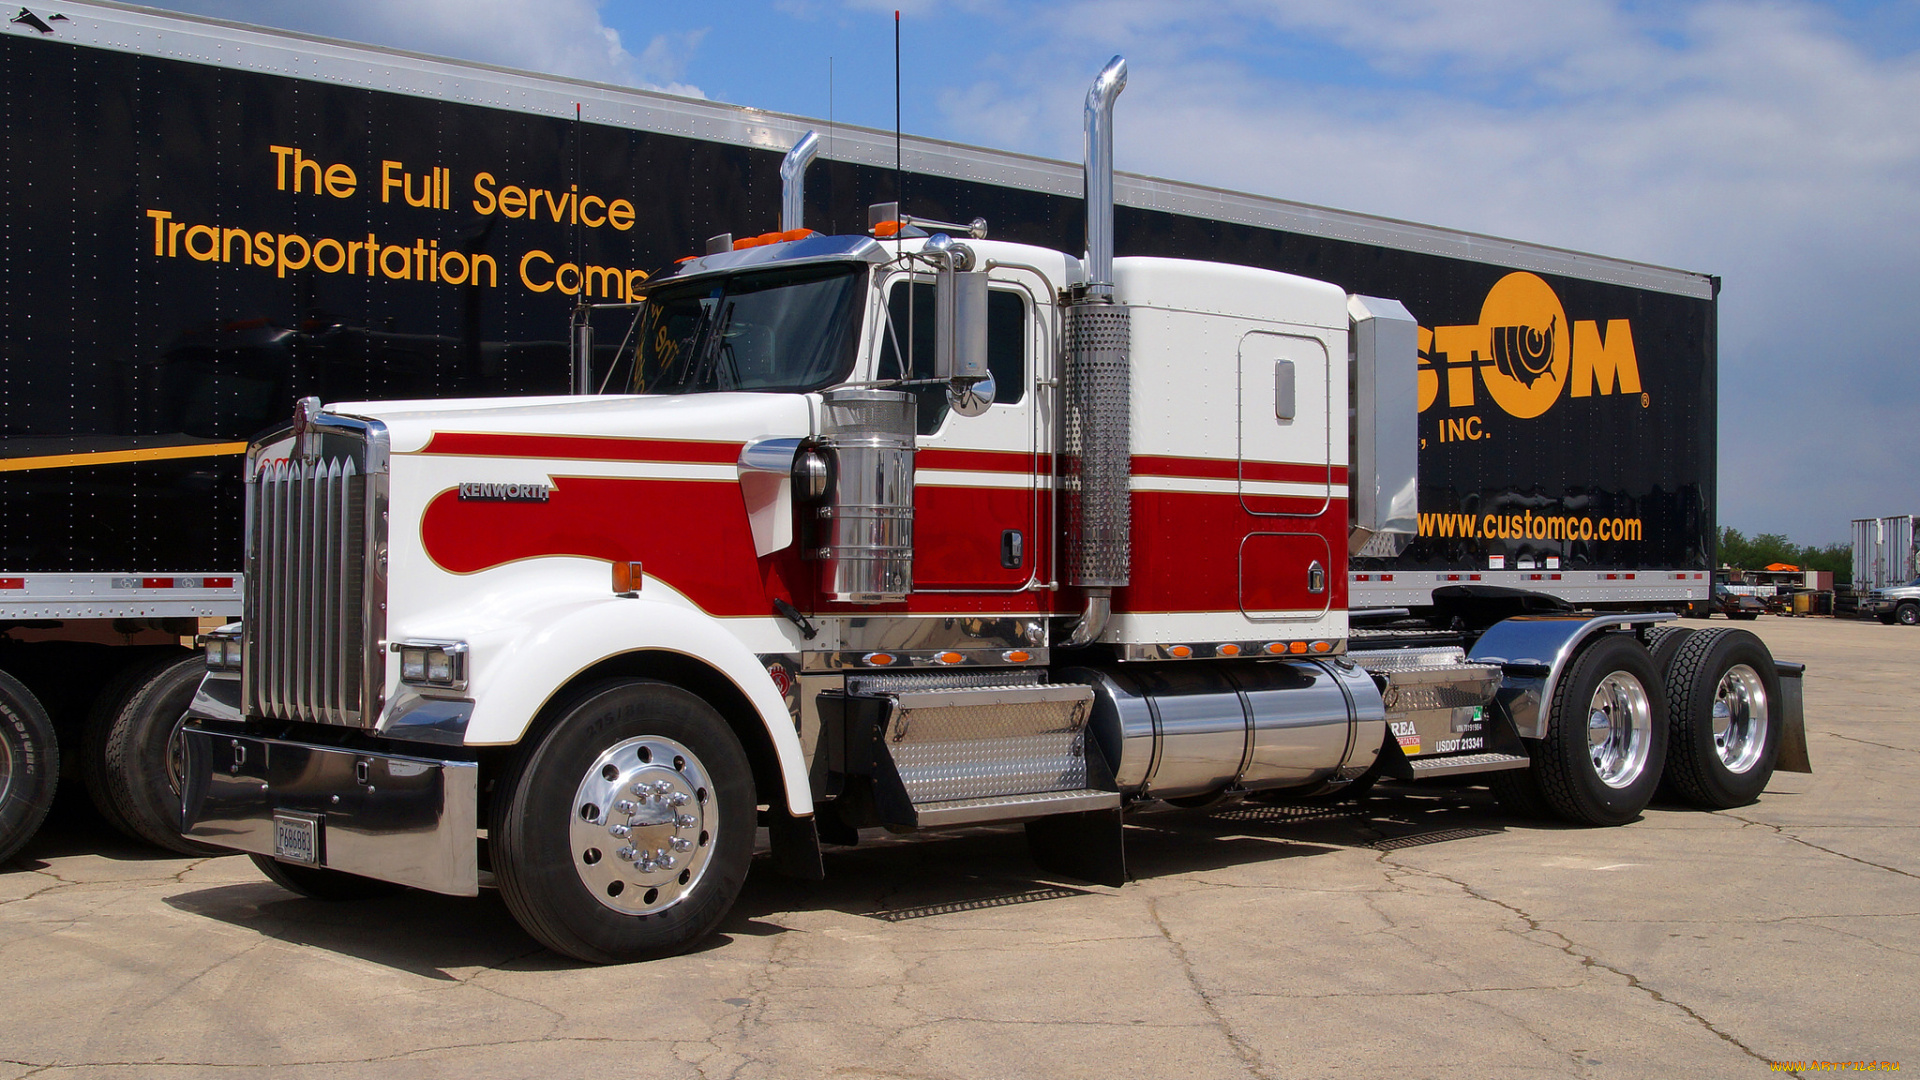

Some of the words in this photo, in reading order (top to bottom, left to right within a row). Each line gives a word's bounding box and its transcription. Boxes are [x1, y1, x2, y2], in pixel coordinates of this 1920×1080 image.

[270, 145, 357, 199] The
[382, 160, 450, 210] Full
[472, 172, 636, 231] Service
[147, 209, 498, 288] Transportation
[1439, 416, 1491, 443] INC.
[459, 482, 549, 498] KENWORTH
[1417, 509, 1642, 541] www.customco.com
[1435, 739, 1461, 752] USDOT
[1461, 737, 1483, 750] 213341
